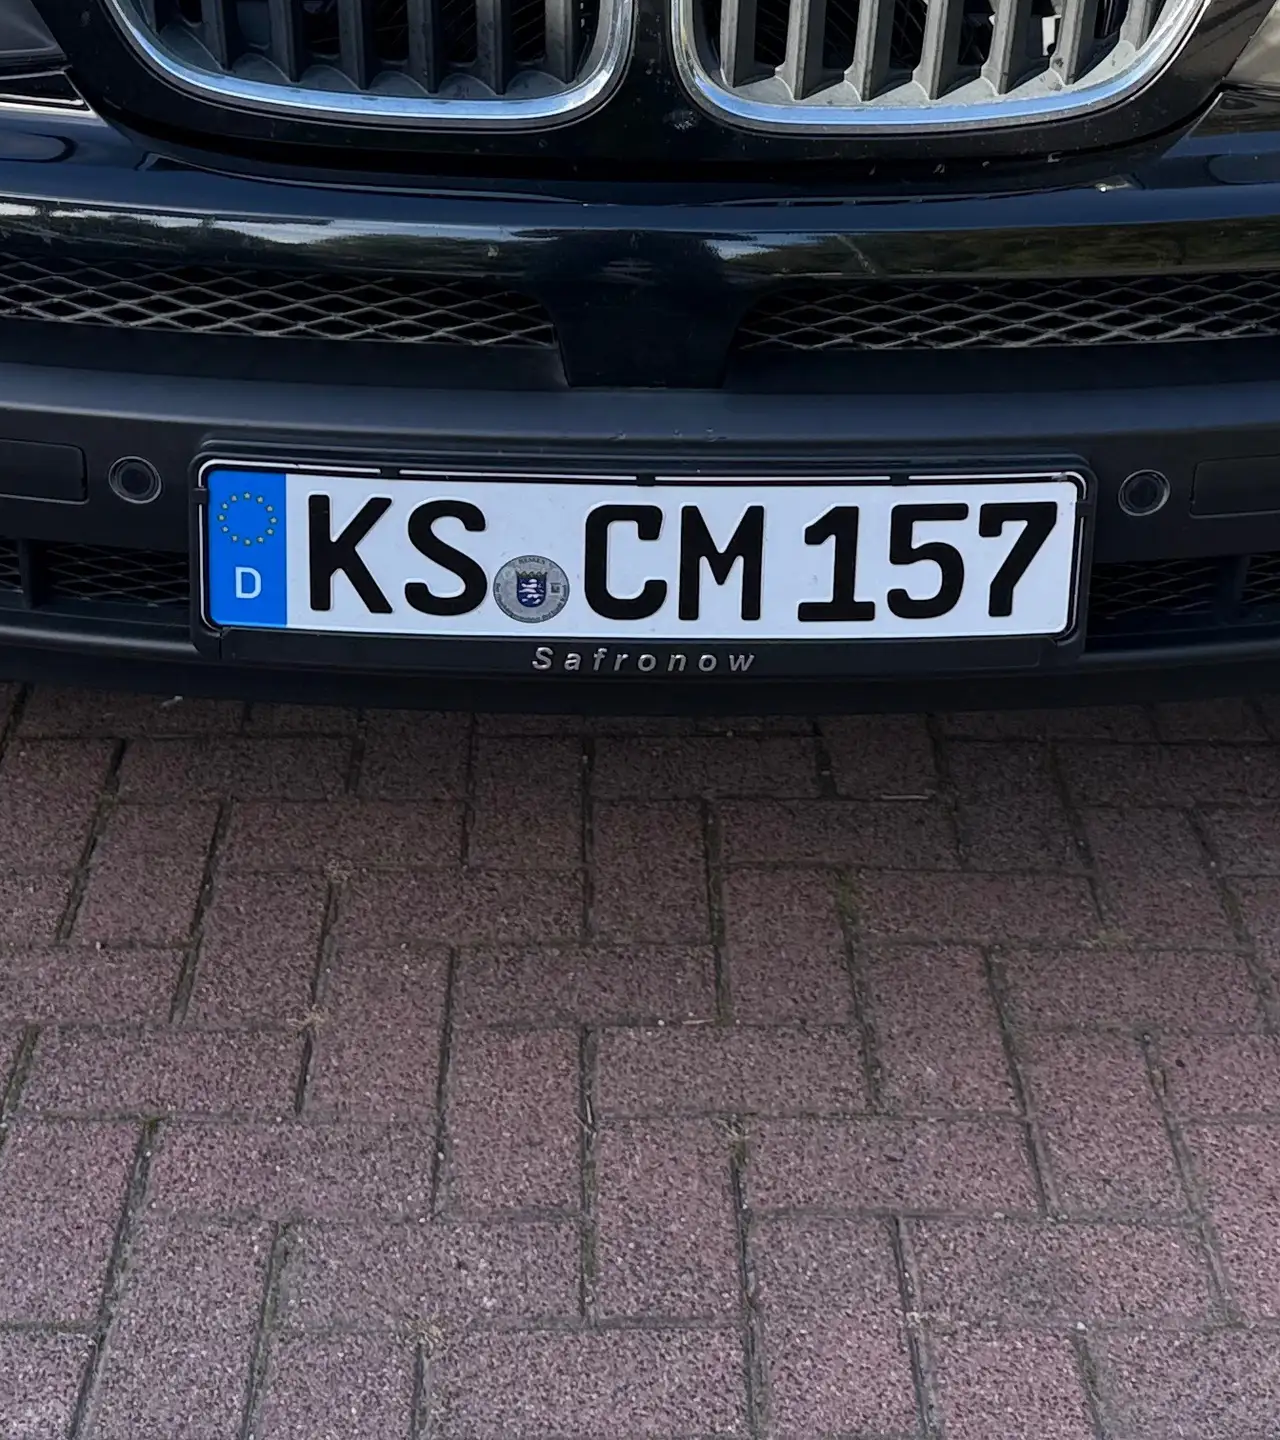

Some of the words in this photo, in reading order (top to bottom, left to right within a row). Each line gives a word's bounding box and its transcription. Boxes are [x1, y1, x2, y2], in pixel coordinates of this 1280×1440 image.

[307, 493, 489, 618] KS
[583, 503, 766, 622] CM
[796, 500, 1059, 624] 157
[234, 566, 262, 600] D
[530, 646, 756, 673] Safronow
